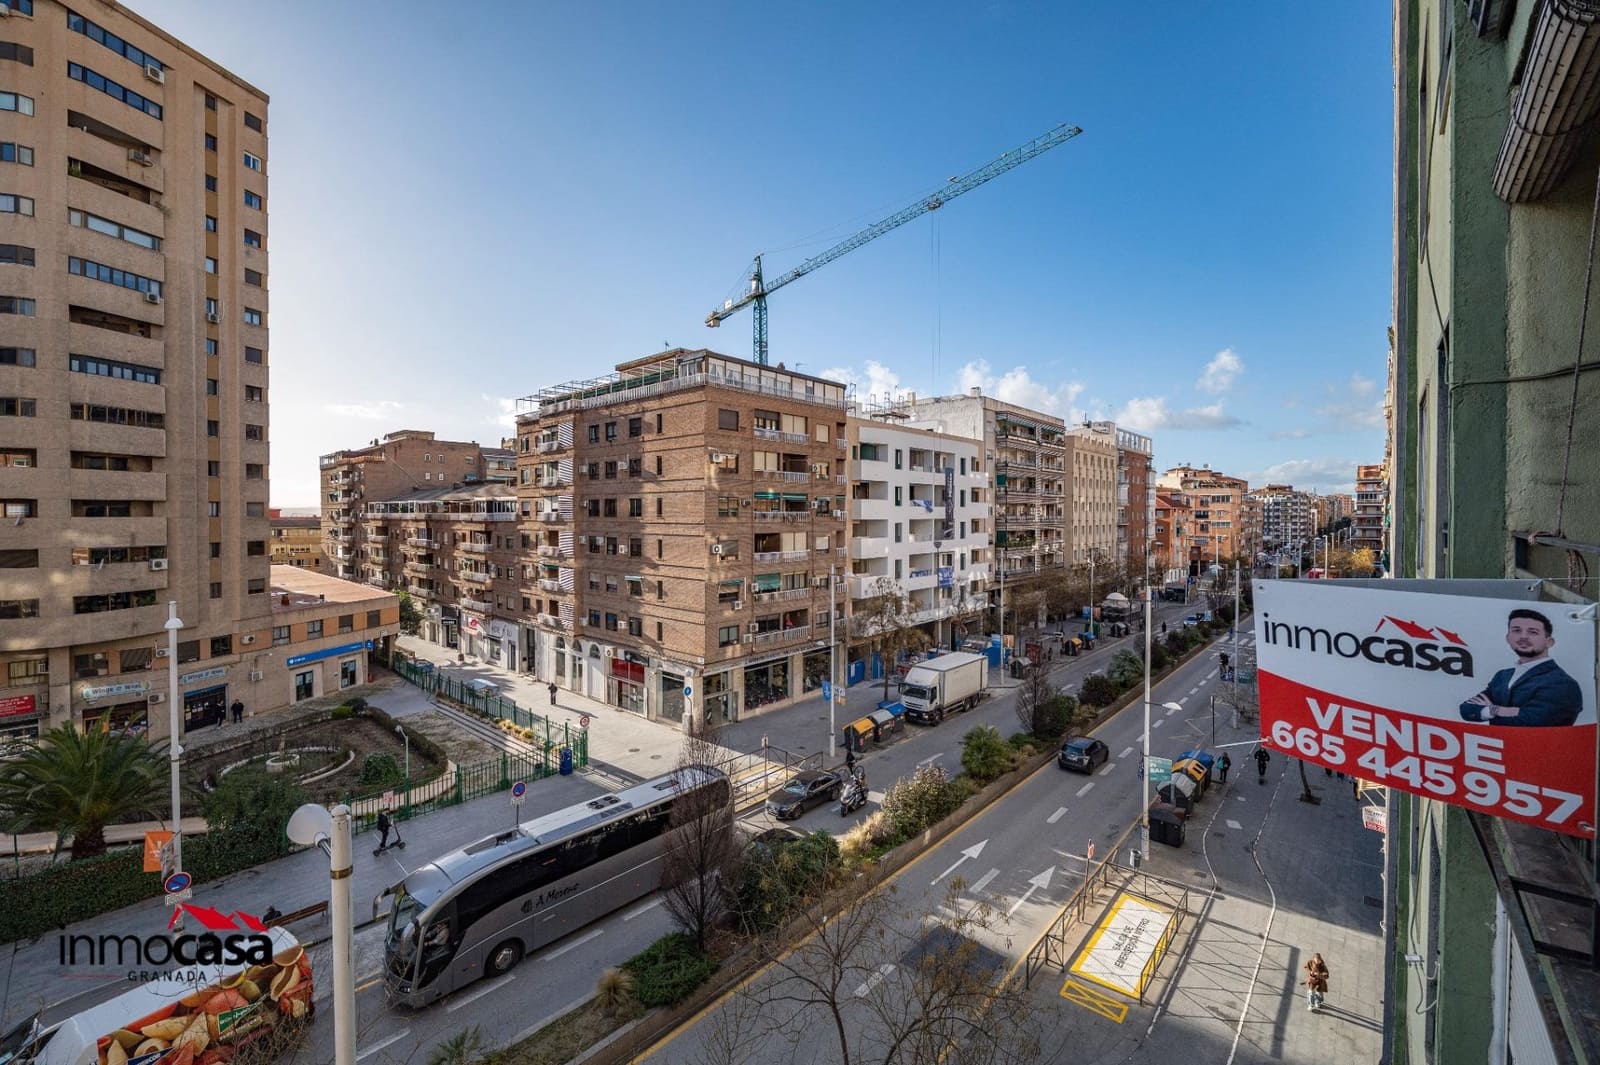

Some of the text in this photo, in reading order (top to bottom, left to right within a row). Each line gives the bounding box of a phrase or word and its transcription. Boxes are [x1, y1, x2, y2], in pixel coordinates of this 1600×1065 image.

[1264, 612, 1474, 678] inmocasa
[1271, 720, 1583, 824] 665 445 957
[1306, 698, 1505, 774] VENDE
